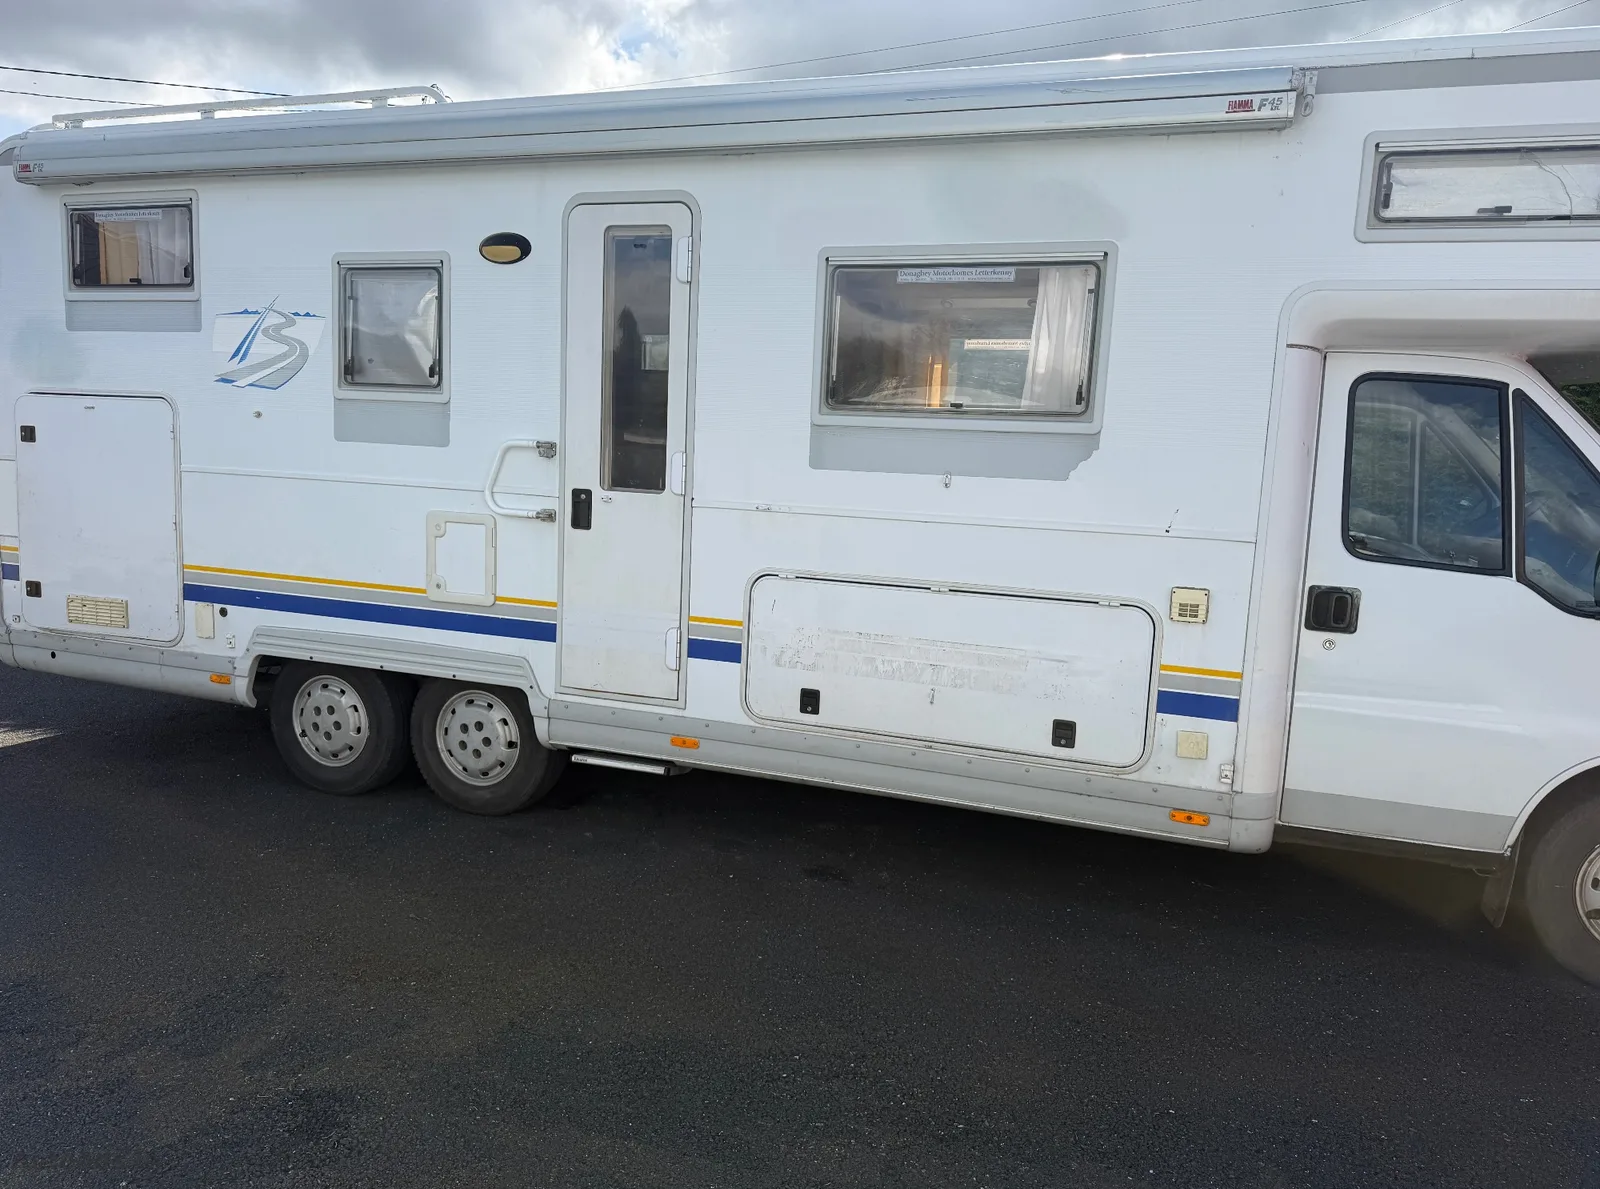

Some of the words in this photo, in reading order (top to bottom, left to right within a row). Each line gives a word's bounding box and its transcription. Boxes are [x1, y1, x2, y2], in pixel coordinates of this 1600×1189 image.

[1227, 99, 1254, 111] FIAMMA
[899, 270, 931, 278] Donaghey
[932, 269, 974, 277] Motorhomes
[974, 268, 1013, 277] Letterkenny
